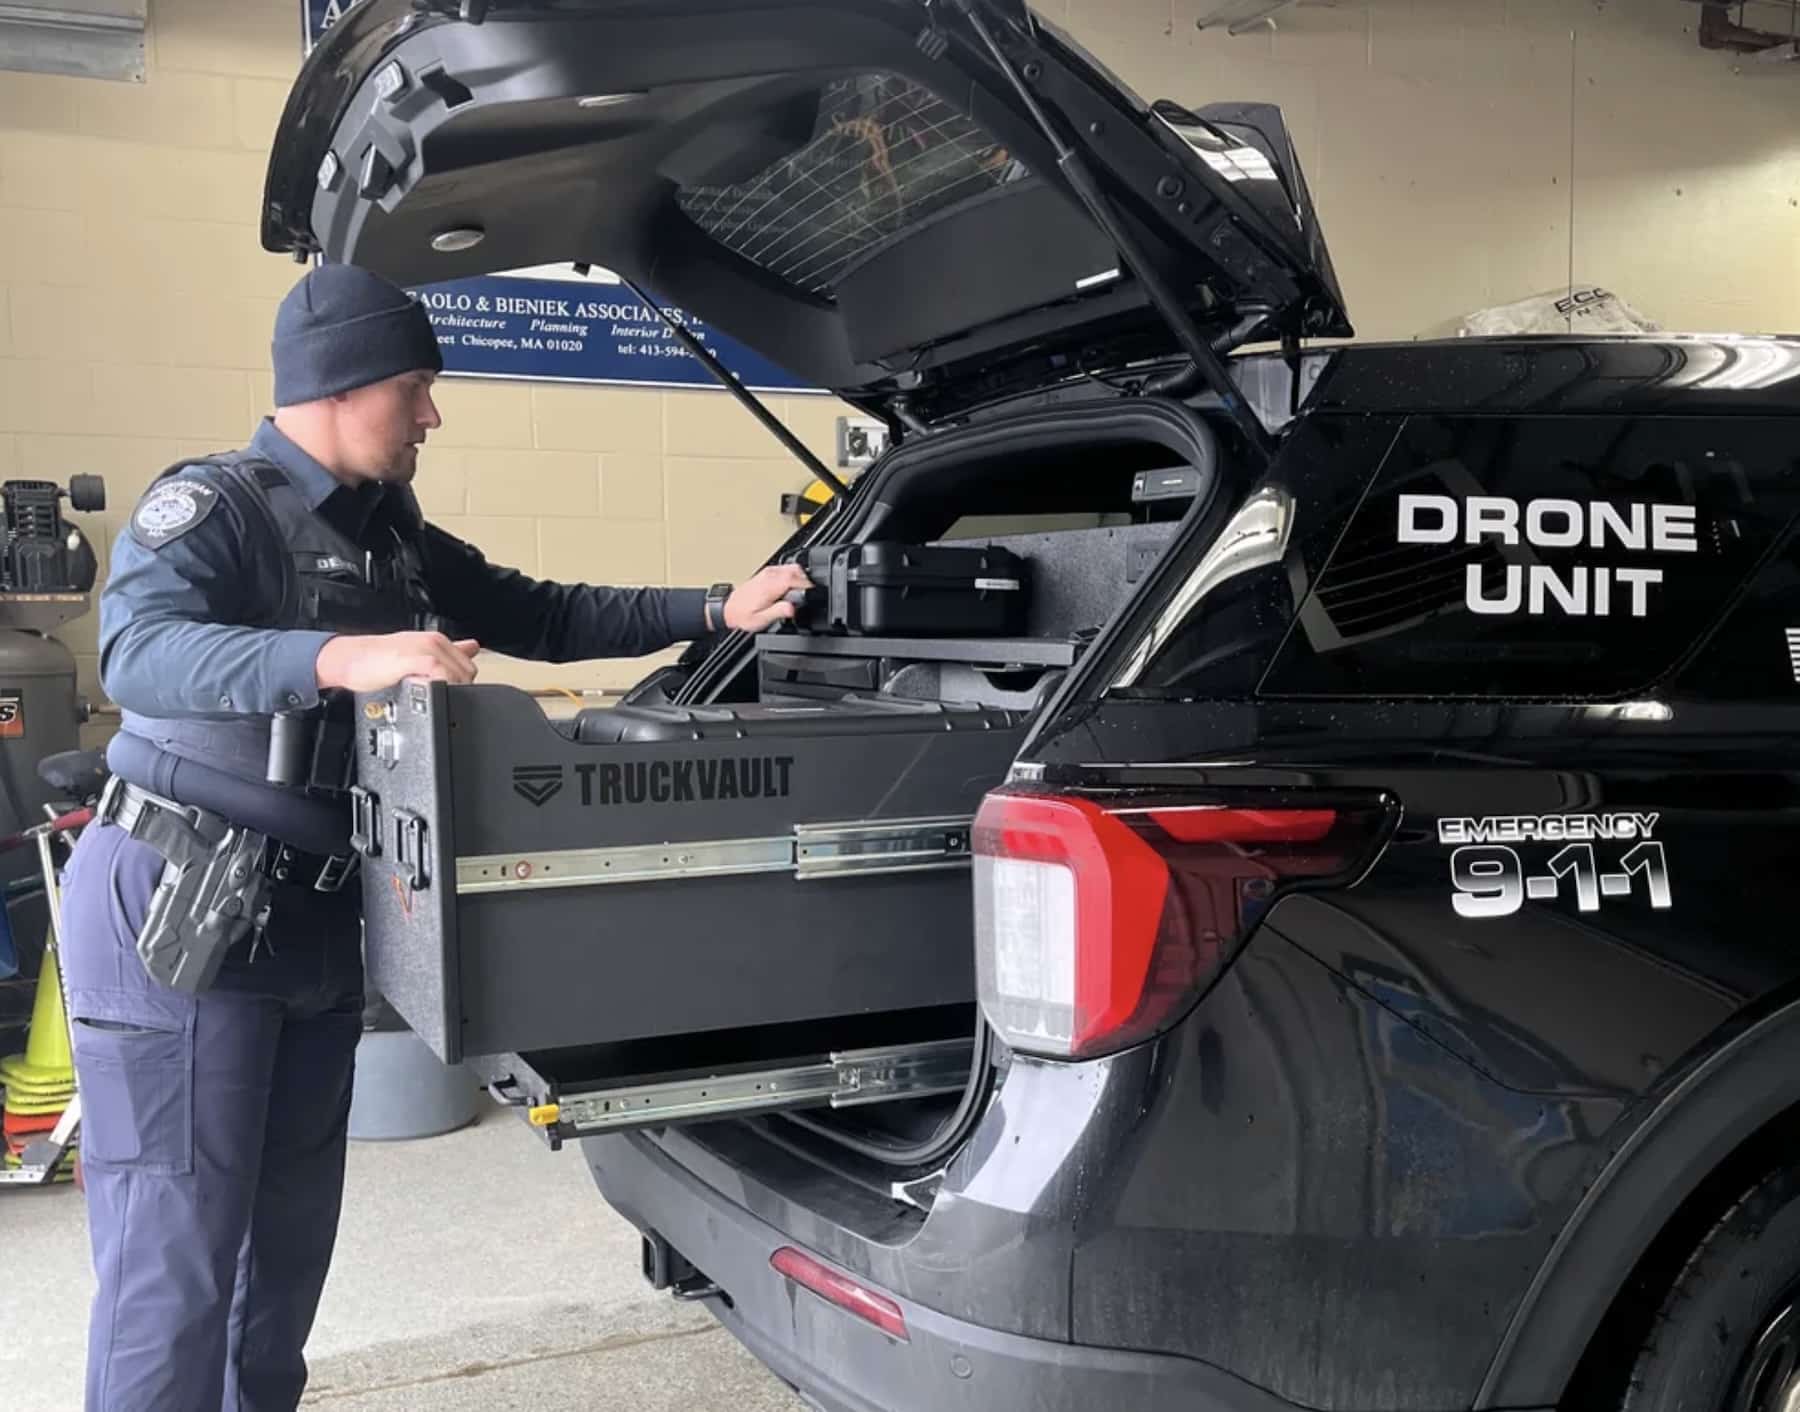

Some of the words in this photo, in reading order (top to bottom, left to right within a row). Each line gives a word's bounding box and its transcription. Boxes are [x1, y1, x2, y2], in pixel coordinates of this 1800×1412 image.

[475, 296, 491, 312] &
[496, 297, 571, 317] BIENIEK
[462, 334, 518, 350] Chicopee,
[520, 337, 545, 350] MA
[546, 339, 583, 352] 01020
[529, 318, 589, 337] Planning
[610, 324, 659, 339] Interior
[617, 343, 637, 355] tel:
[1398, 494, 1698, 552] DRONE
[1466, 563, 1663, 616] UNIT
[575, 757, 794, 806] TRUCKVAULT
[1437, 812, 1660, 844] EMERGENCY
[1450, 841, 1673, 918] 9-1-1
